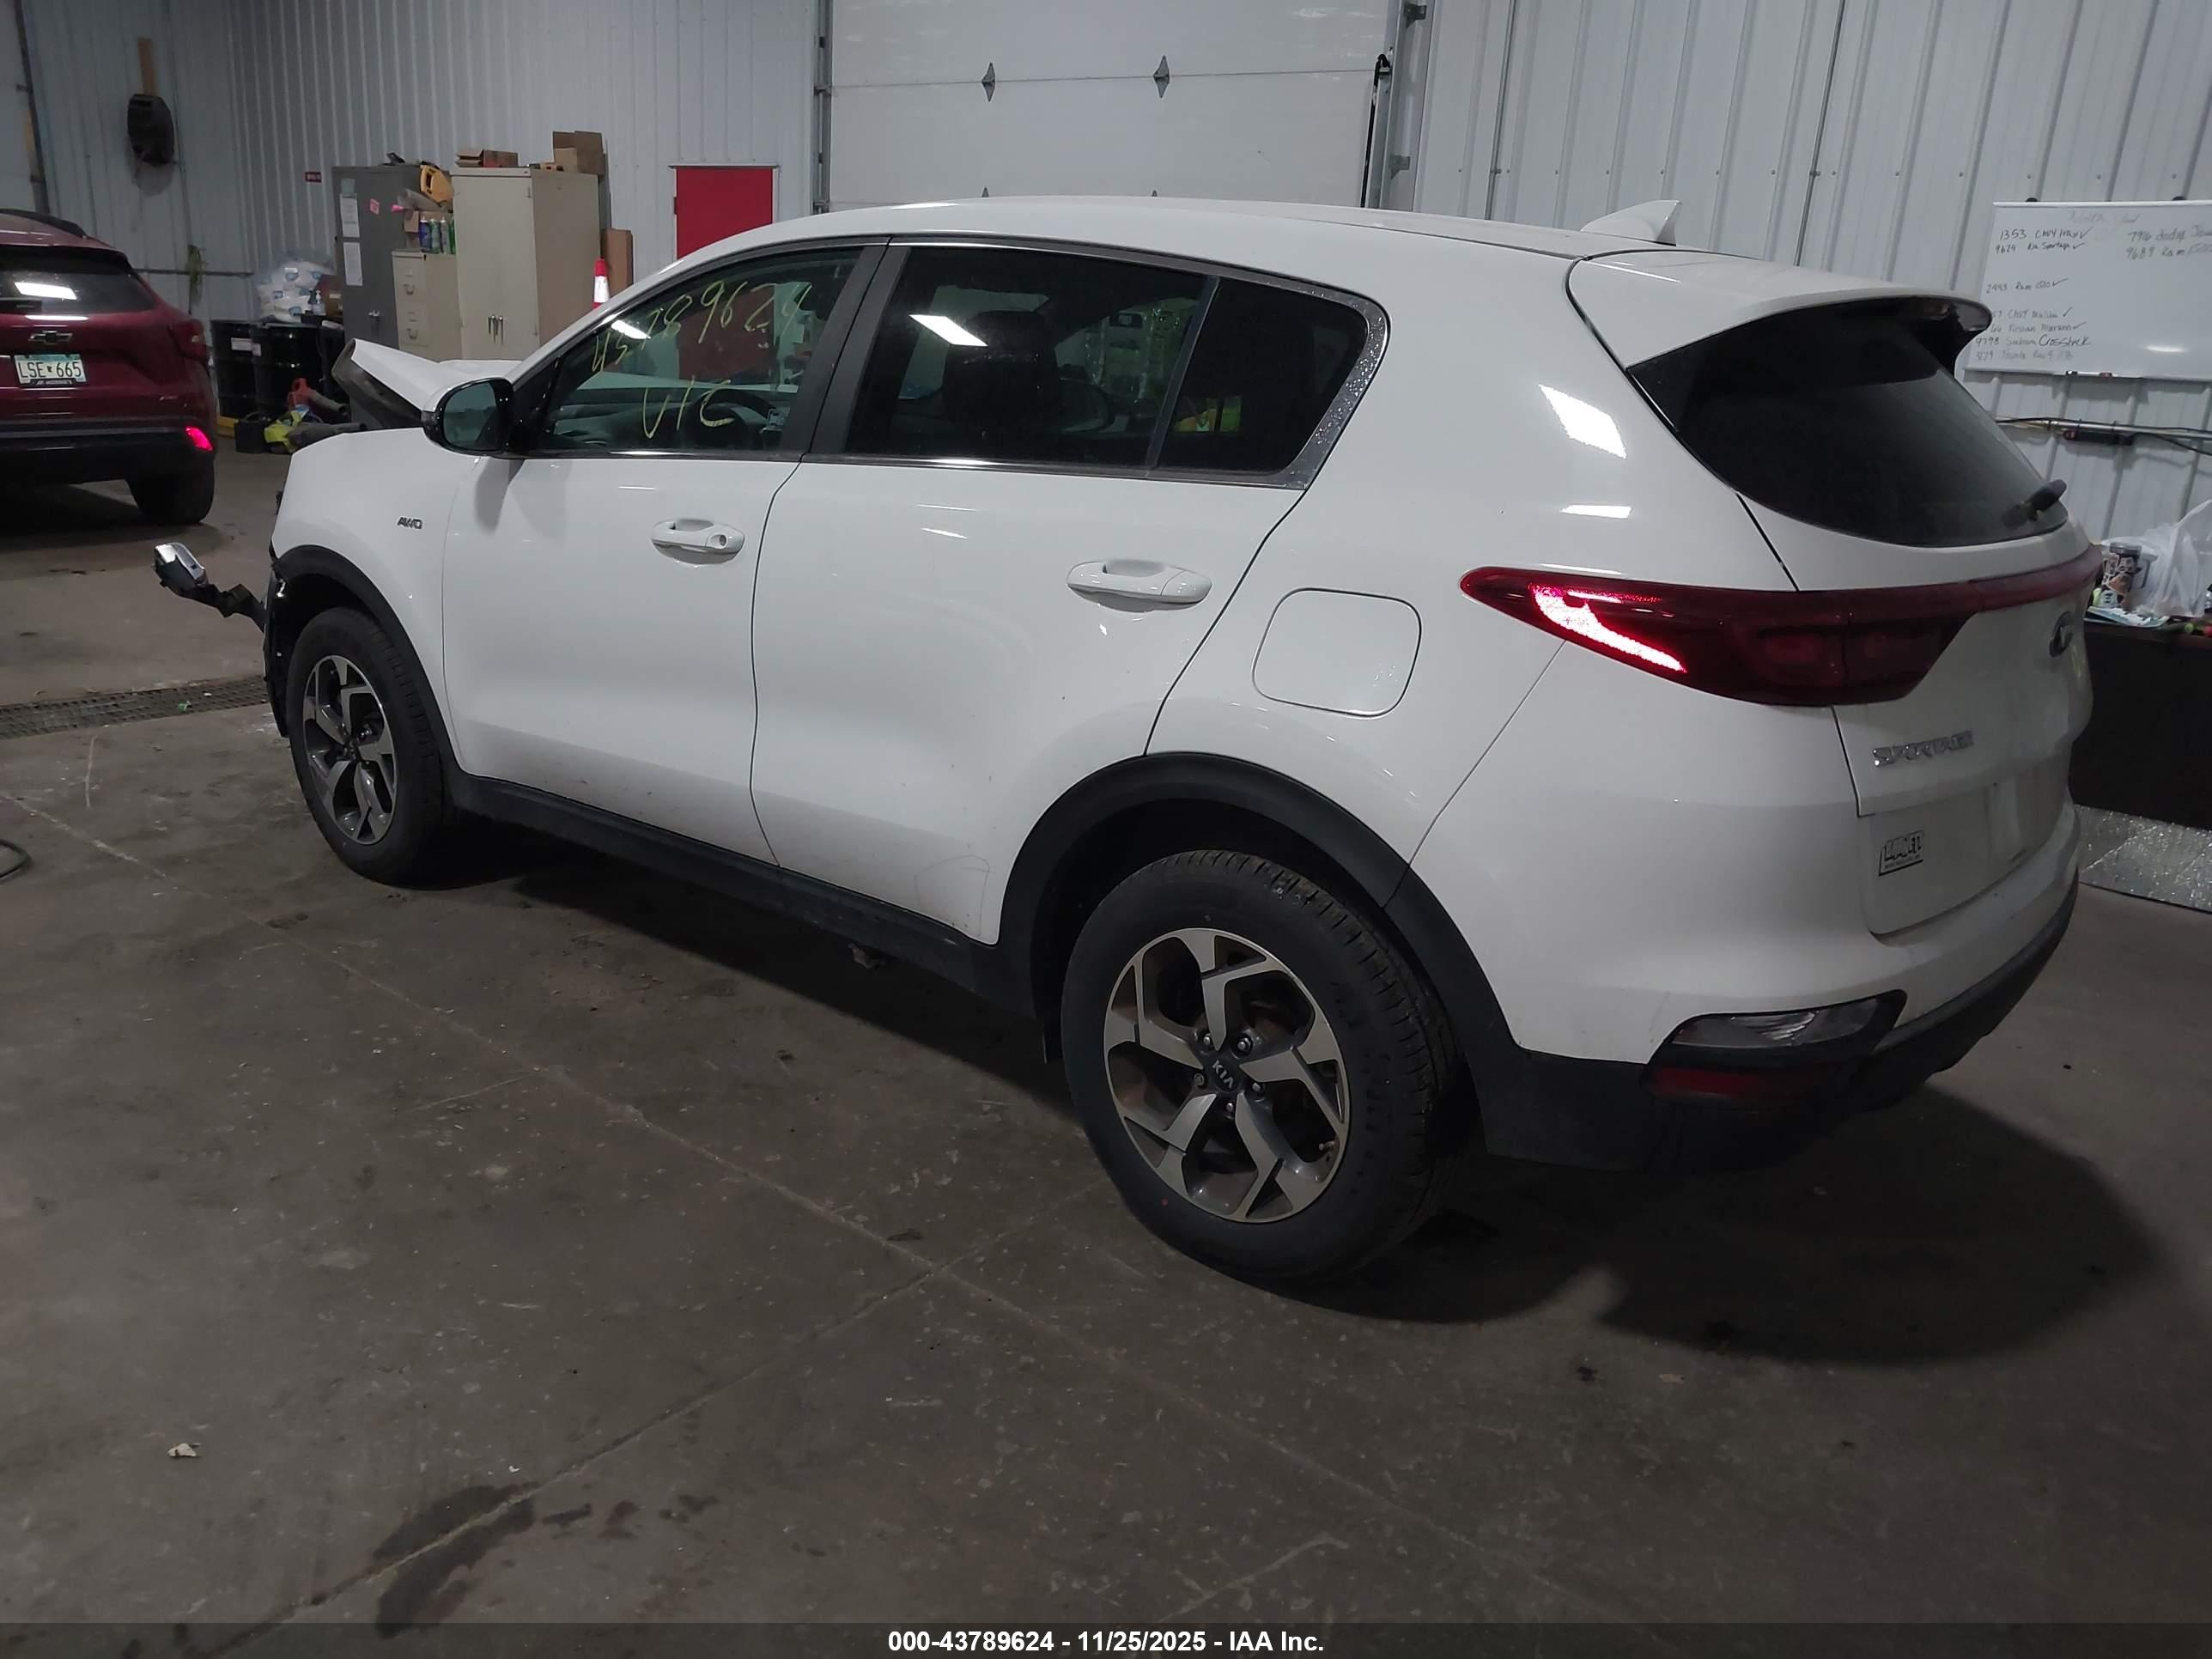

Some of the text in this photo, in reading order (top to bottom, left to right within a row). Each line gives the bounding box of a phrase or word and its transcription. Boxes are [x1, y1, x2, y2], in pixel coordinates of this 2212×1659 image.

[18, 362, 82, 378] LSE 665
[397, 516, 423, 530] AWD
[1212, 1060, 1234, 1089] KIA
